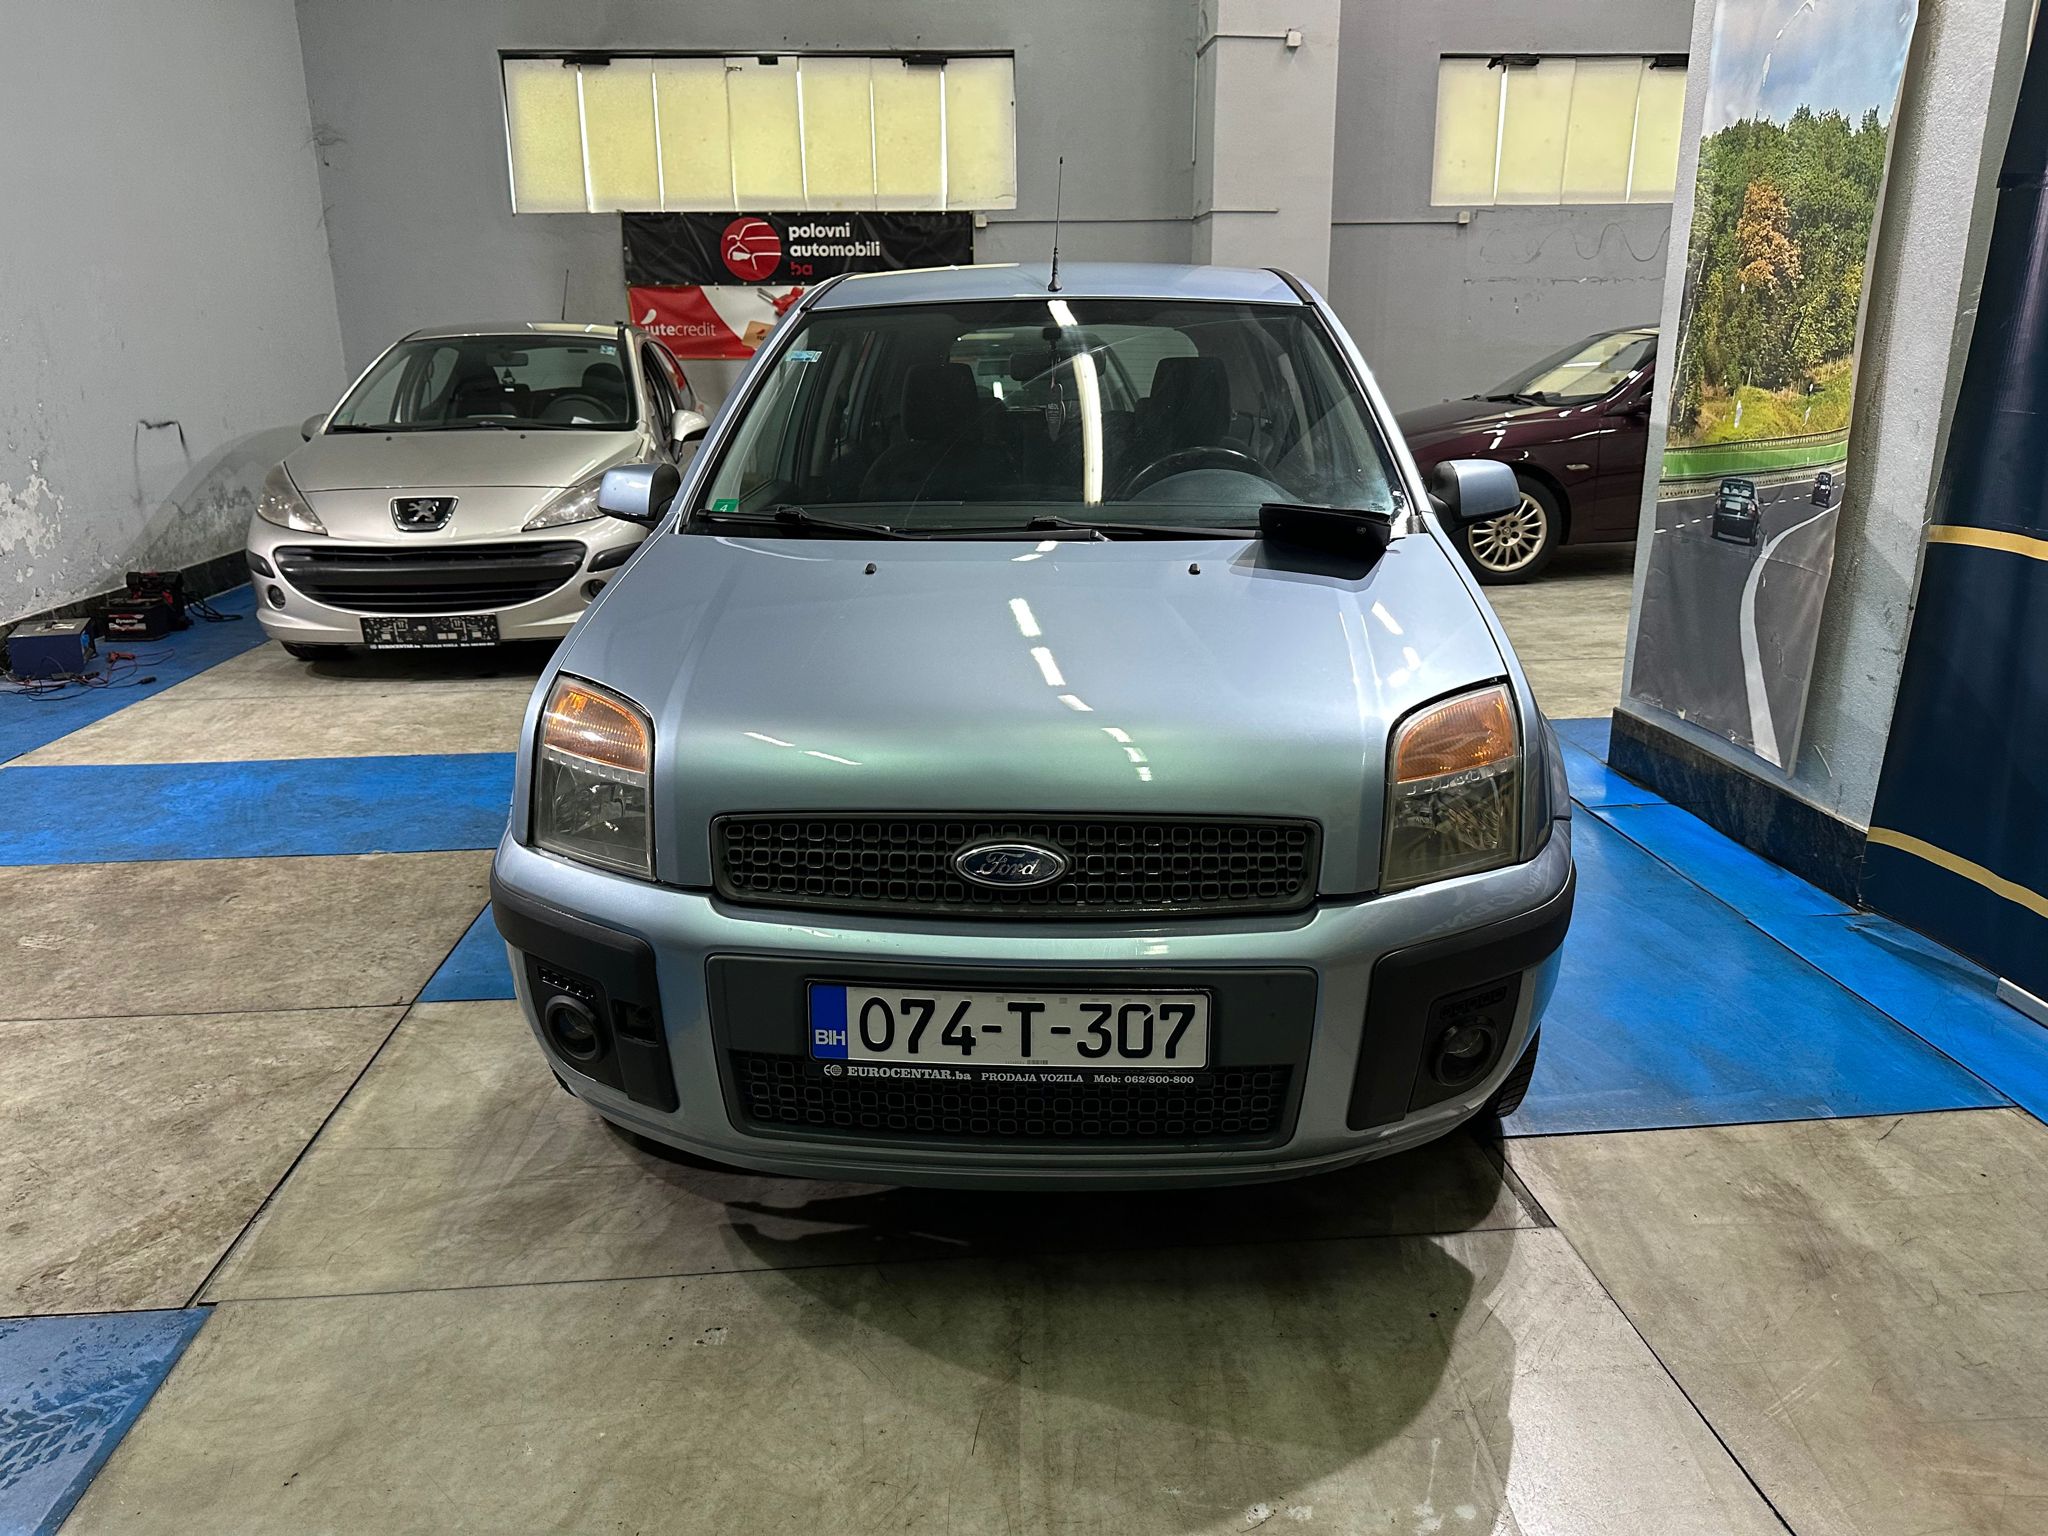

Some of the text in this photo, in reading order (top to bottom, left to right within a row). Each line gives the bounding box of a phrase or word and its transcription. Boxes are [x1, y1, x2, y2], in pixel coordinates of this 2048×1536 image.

[788, 222, 850, 241] polovni
[789, 240, 881, 257] automobili
[976, 851, 1040, 875] Ford
[859, 996, 1196, 1059] 074-T-307
[815, 1029, 846, 1046] BIH
[847, 1066, 1194, 1085] EUROCENTAR.ba PRODAJA VOZILA Mob: 062/800-800
